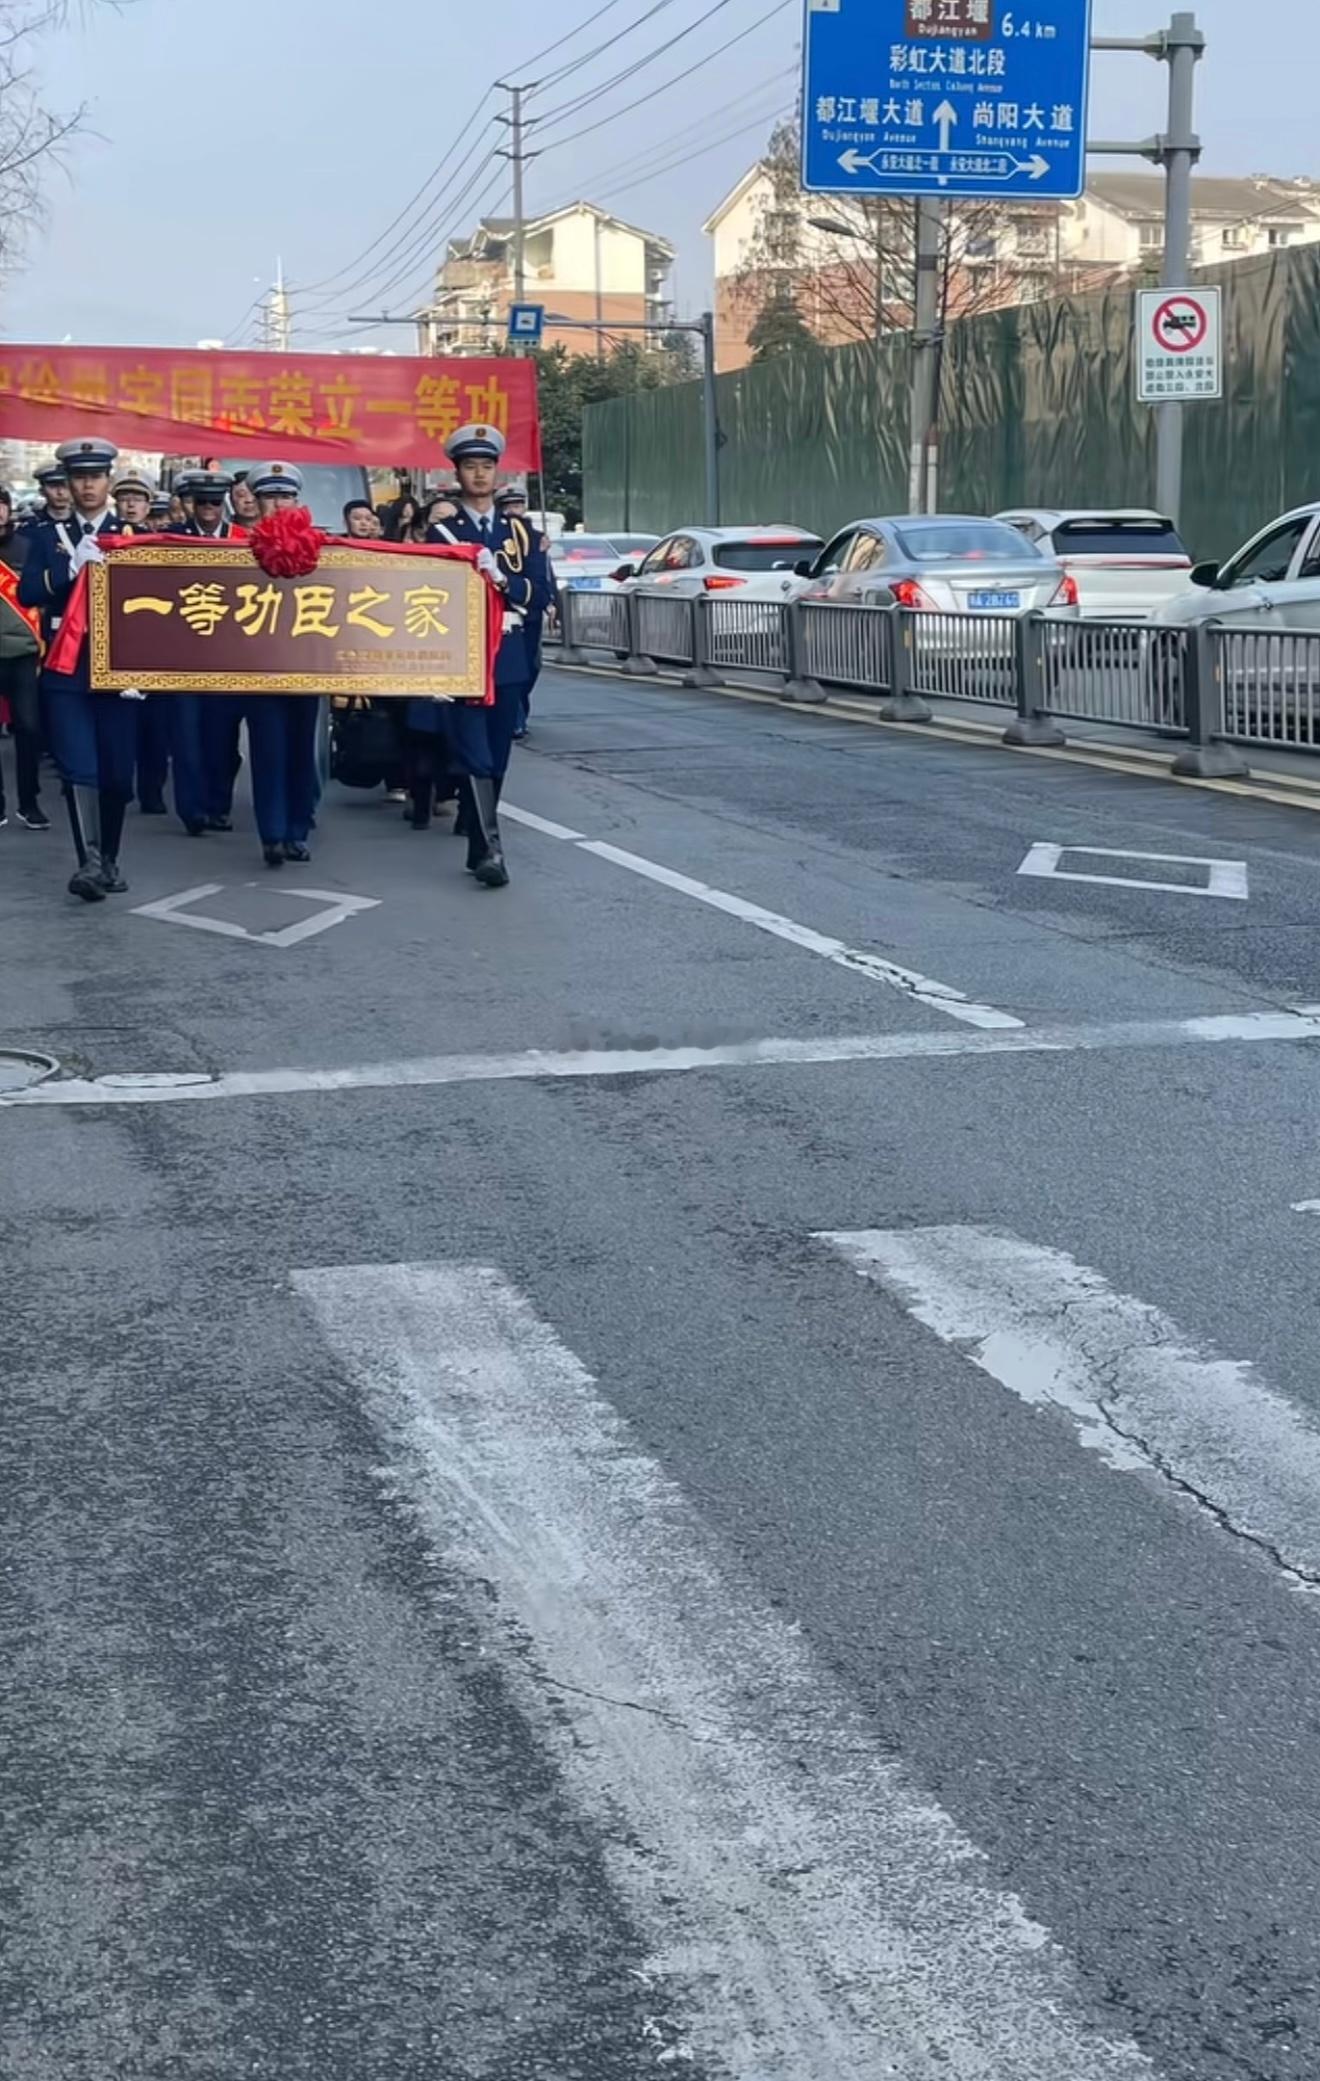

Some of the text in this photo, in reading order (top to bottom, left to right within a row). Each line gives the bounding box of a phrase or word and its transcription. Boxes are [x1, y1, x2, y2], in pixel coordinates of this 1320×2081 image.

[908, 0, 989, 23] 都江堰
[1001, 12, 1056, 38] 6.4 km
[889, 44, 1006, 76] 彩虹大道北段
[816, 96, 924, 126] 都江堰大道
[972, 102, 1074, 132] 尚阳大道
[123, 582, 451, 638] 一等功臣之家
